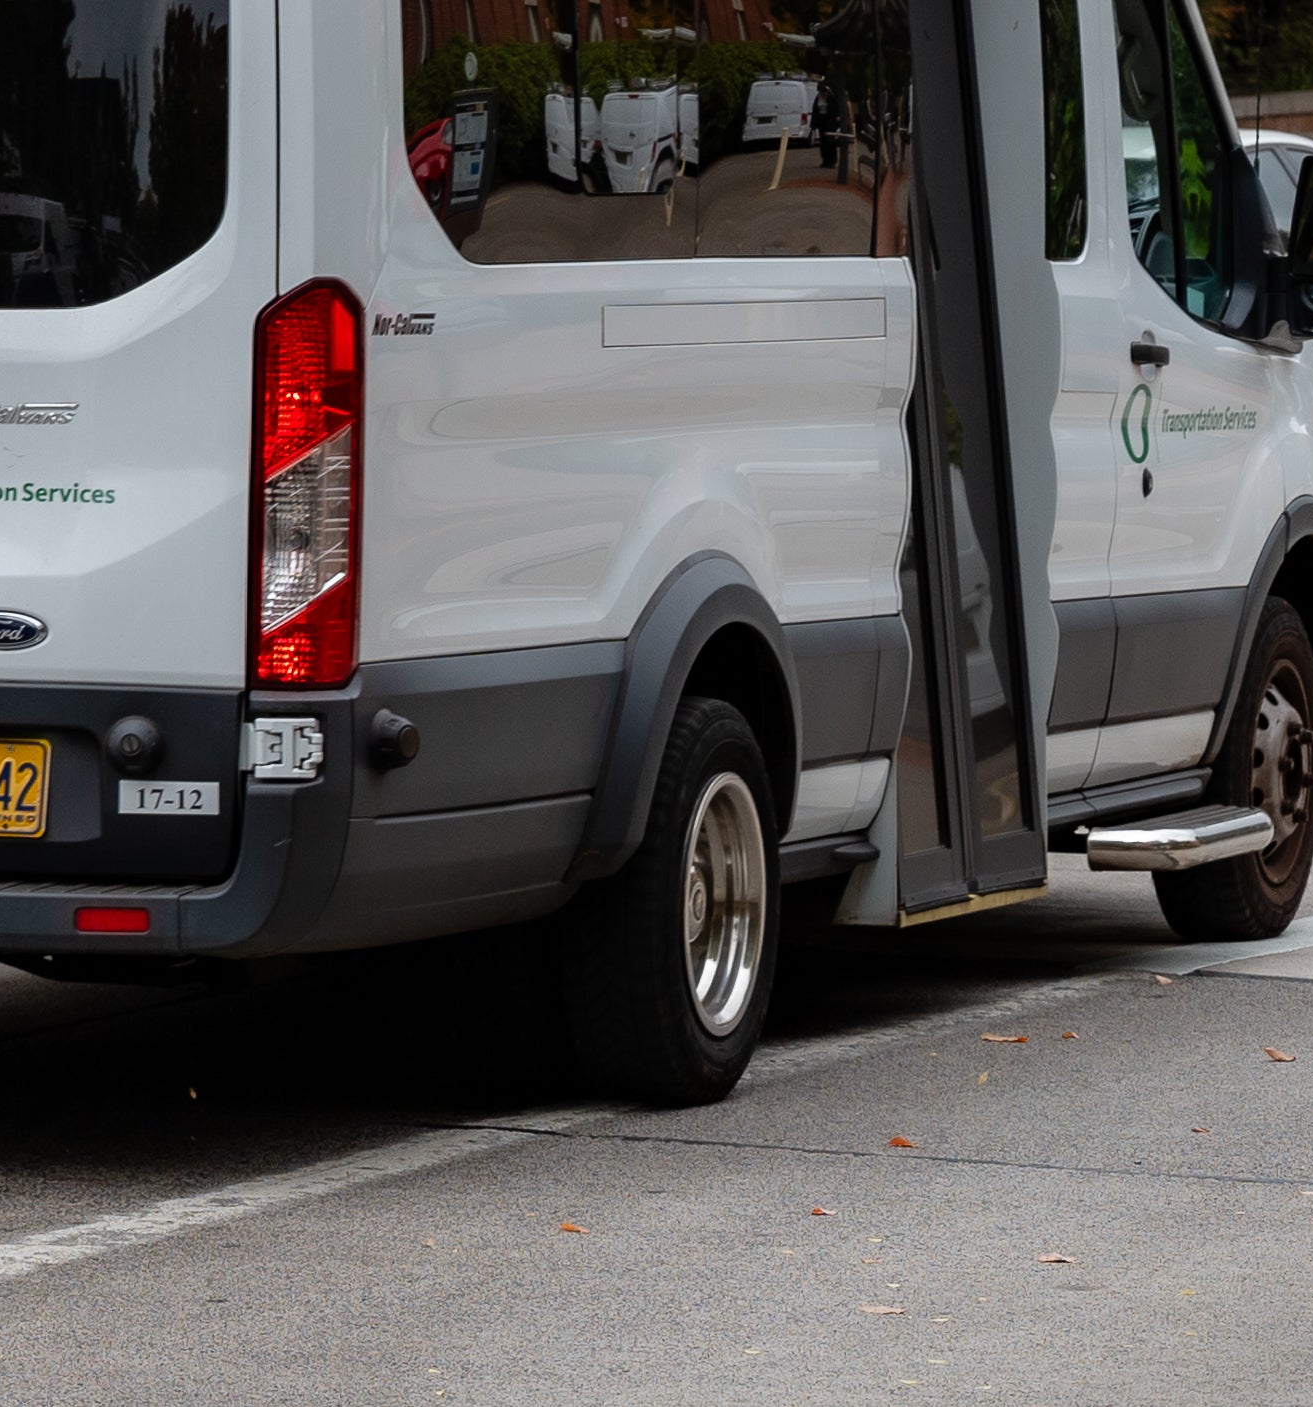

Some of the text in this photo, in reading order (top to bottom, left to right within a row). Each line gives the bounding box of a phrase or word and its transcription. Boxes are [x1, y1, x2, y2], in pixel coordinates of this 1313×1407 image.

[1161, 404, 1258, 439] Transportation Services
[22, 482, 116, 504] Services
[135, 788, 203, 810] 17-12
